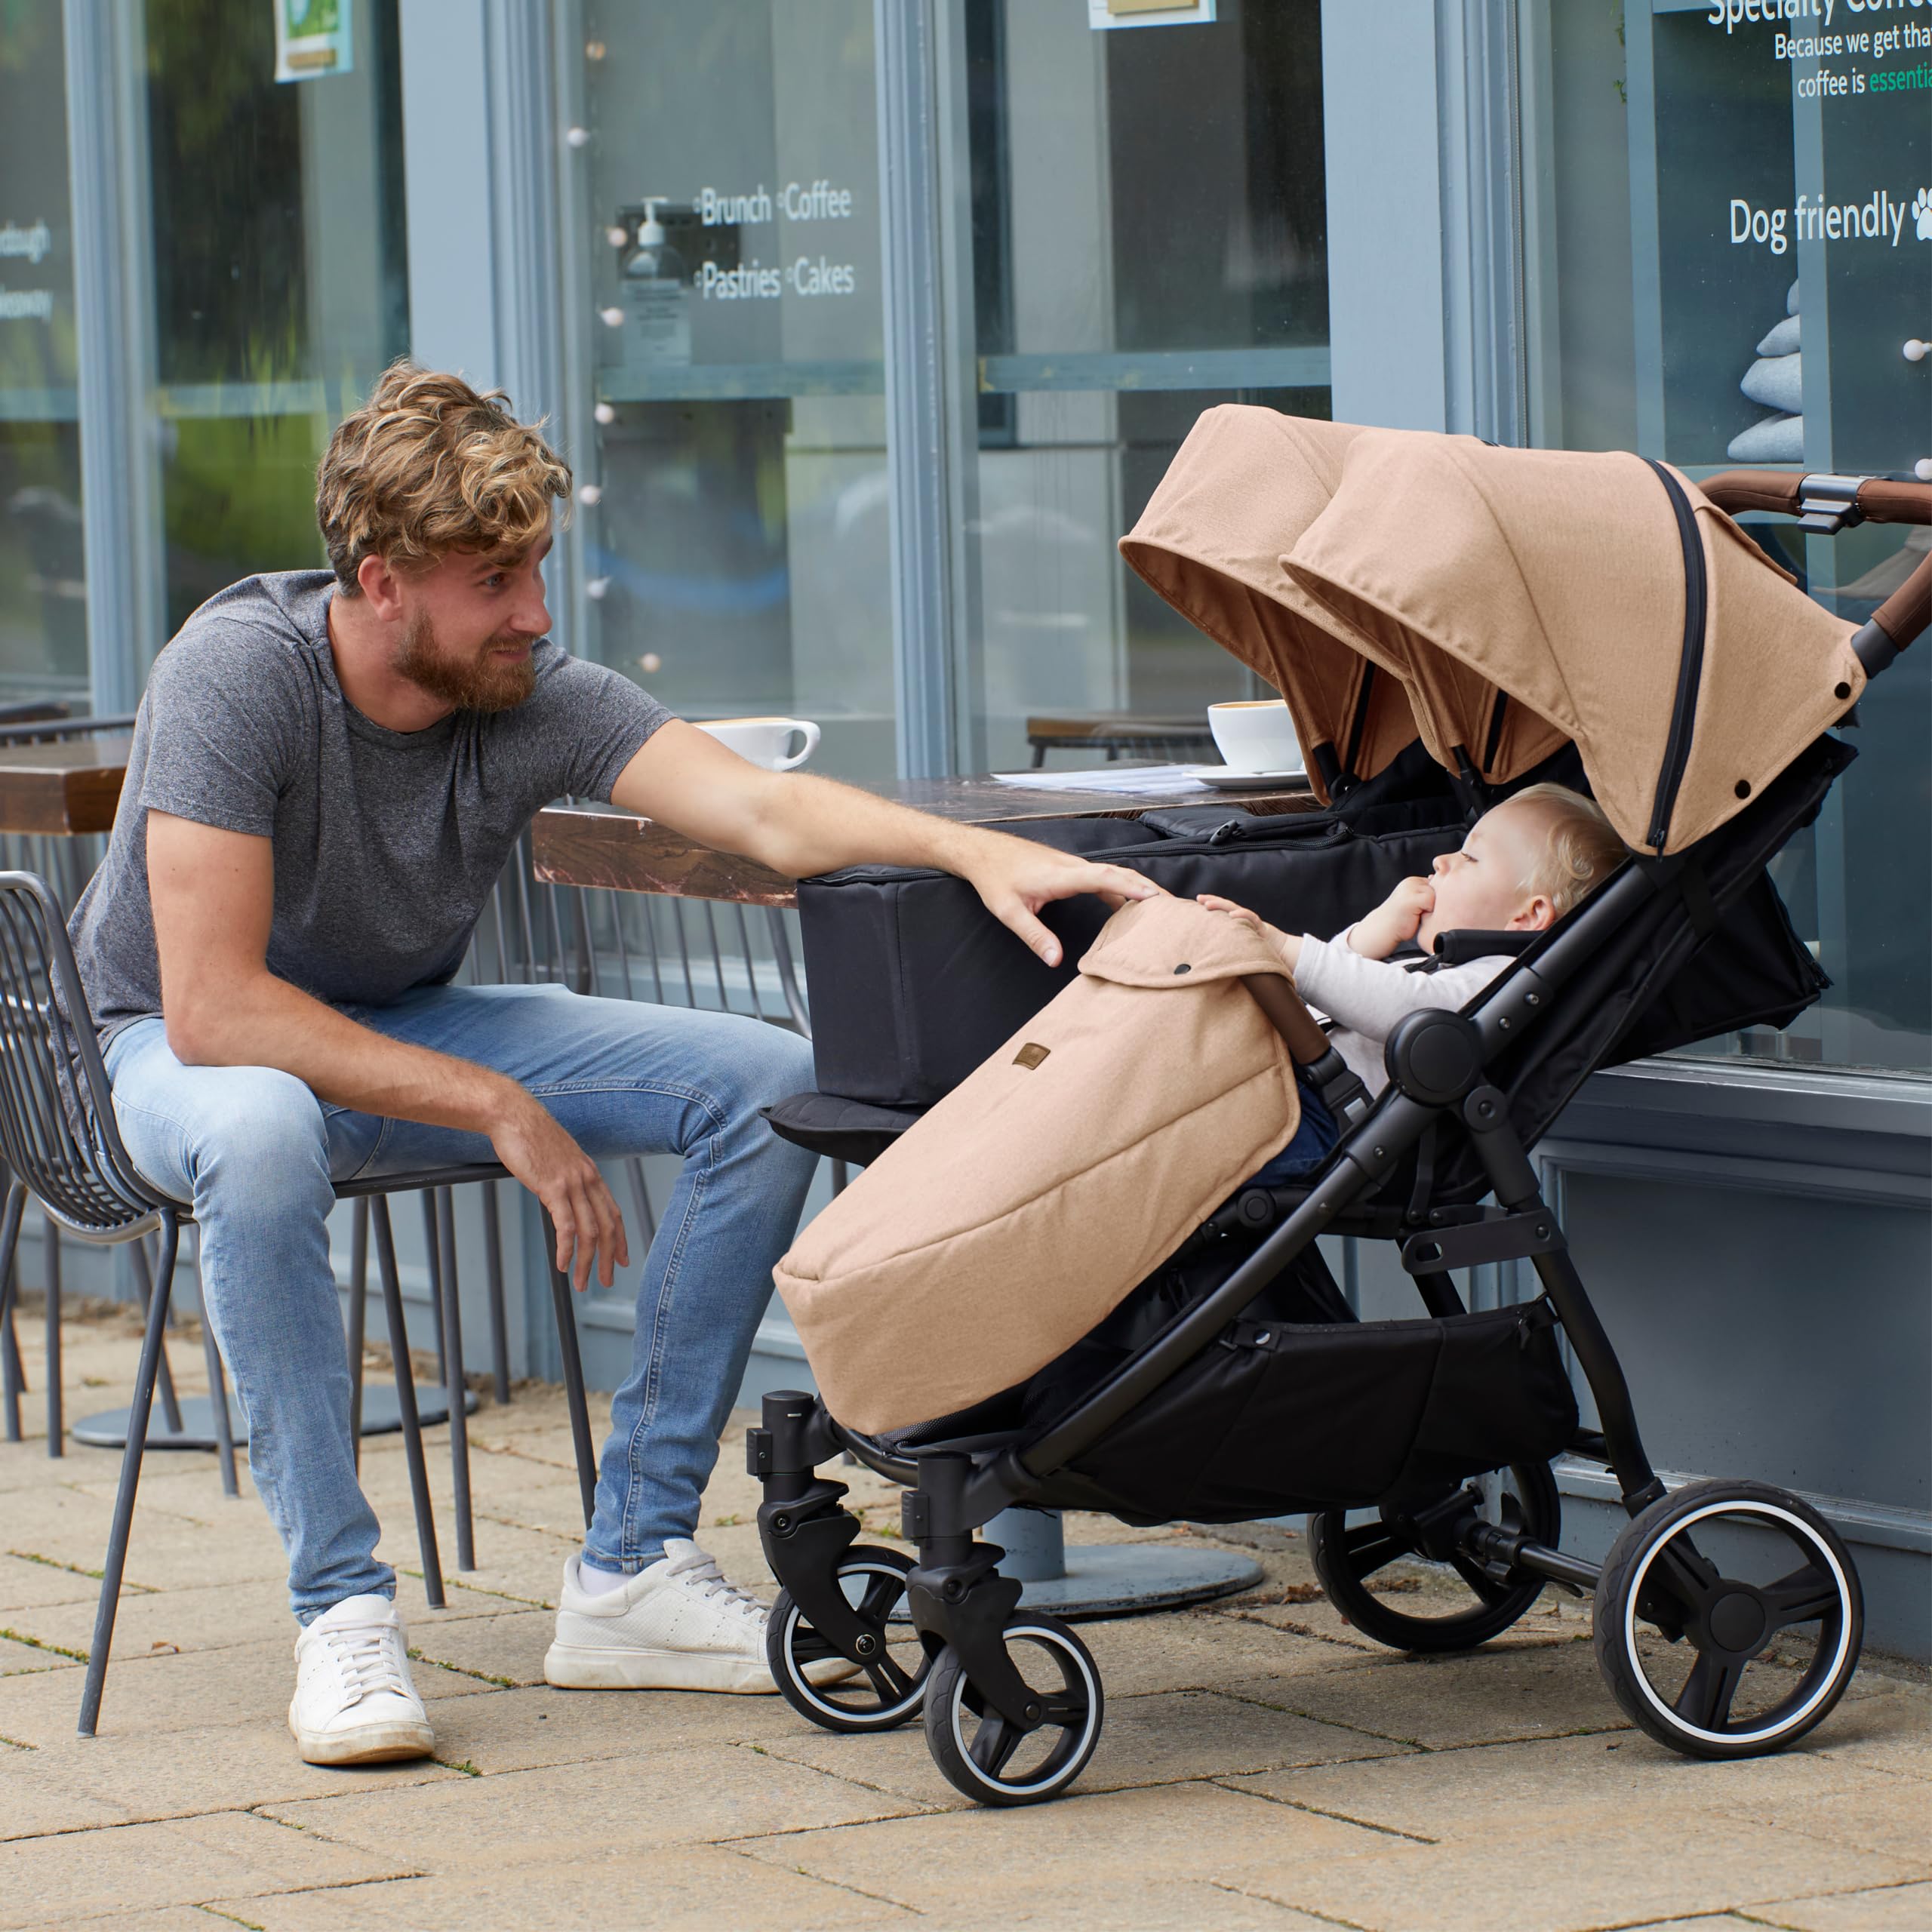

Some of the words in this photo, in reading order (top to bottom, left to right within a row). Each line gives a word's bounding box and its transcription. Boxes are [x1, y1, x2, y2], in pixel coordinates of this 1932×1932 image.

[1775, 33, 1842, 59] Because
[1846, 32, 1869, 53] we
[1873, 25, 1900, 58] get
[1903, 21, 1932, 48] tha
[1798, 69, 1847, 97] coffee
[1852, 67, 1865, 94] is
[701, 183, 772, 226] Brunch
[785, 179, 852, 221] Coffee
[1730, 199, 1787, 254] Dog
[1794, 190, 1906, 247] friendly
[702, 258, 781, 300] Pastries
[795, 255, 855, 296] Cakes
